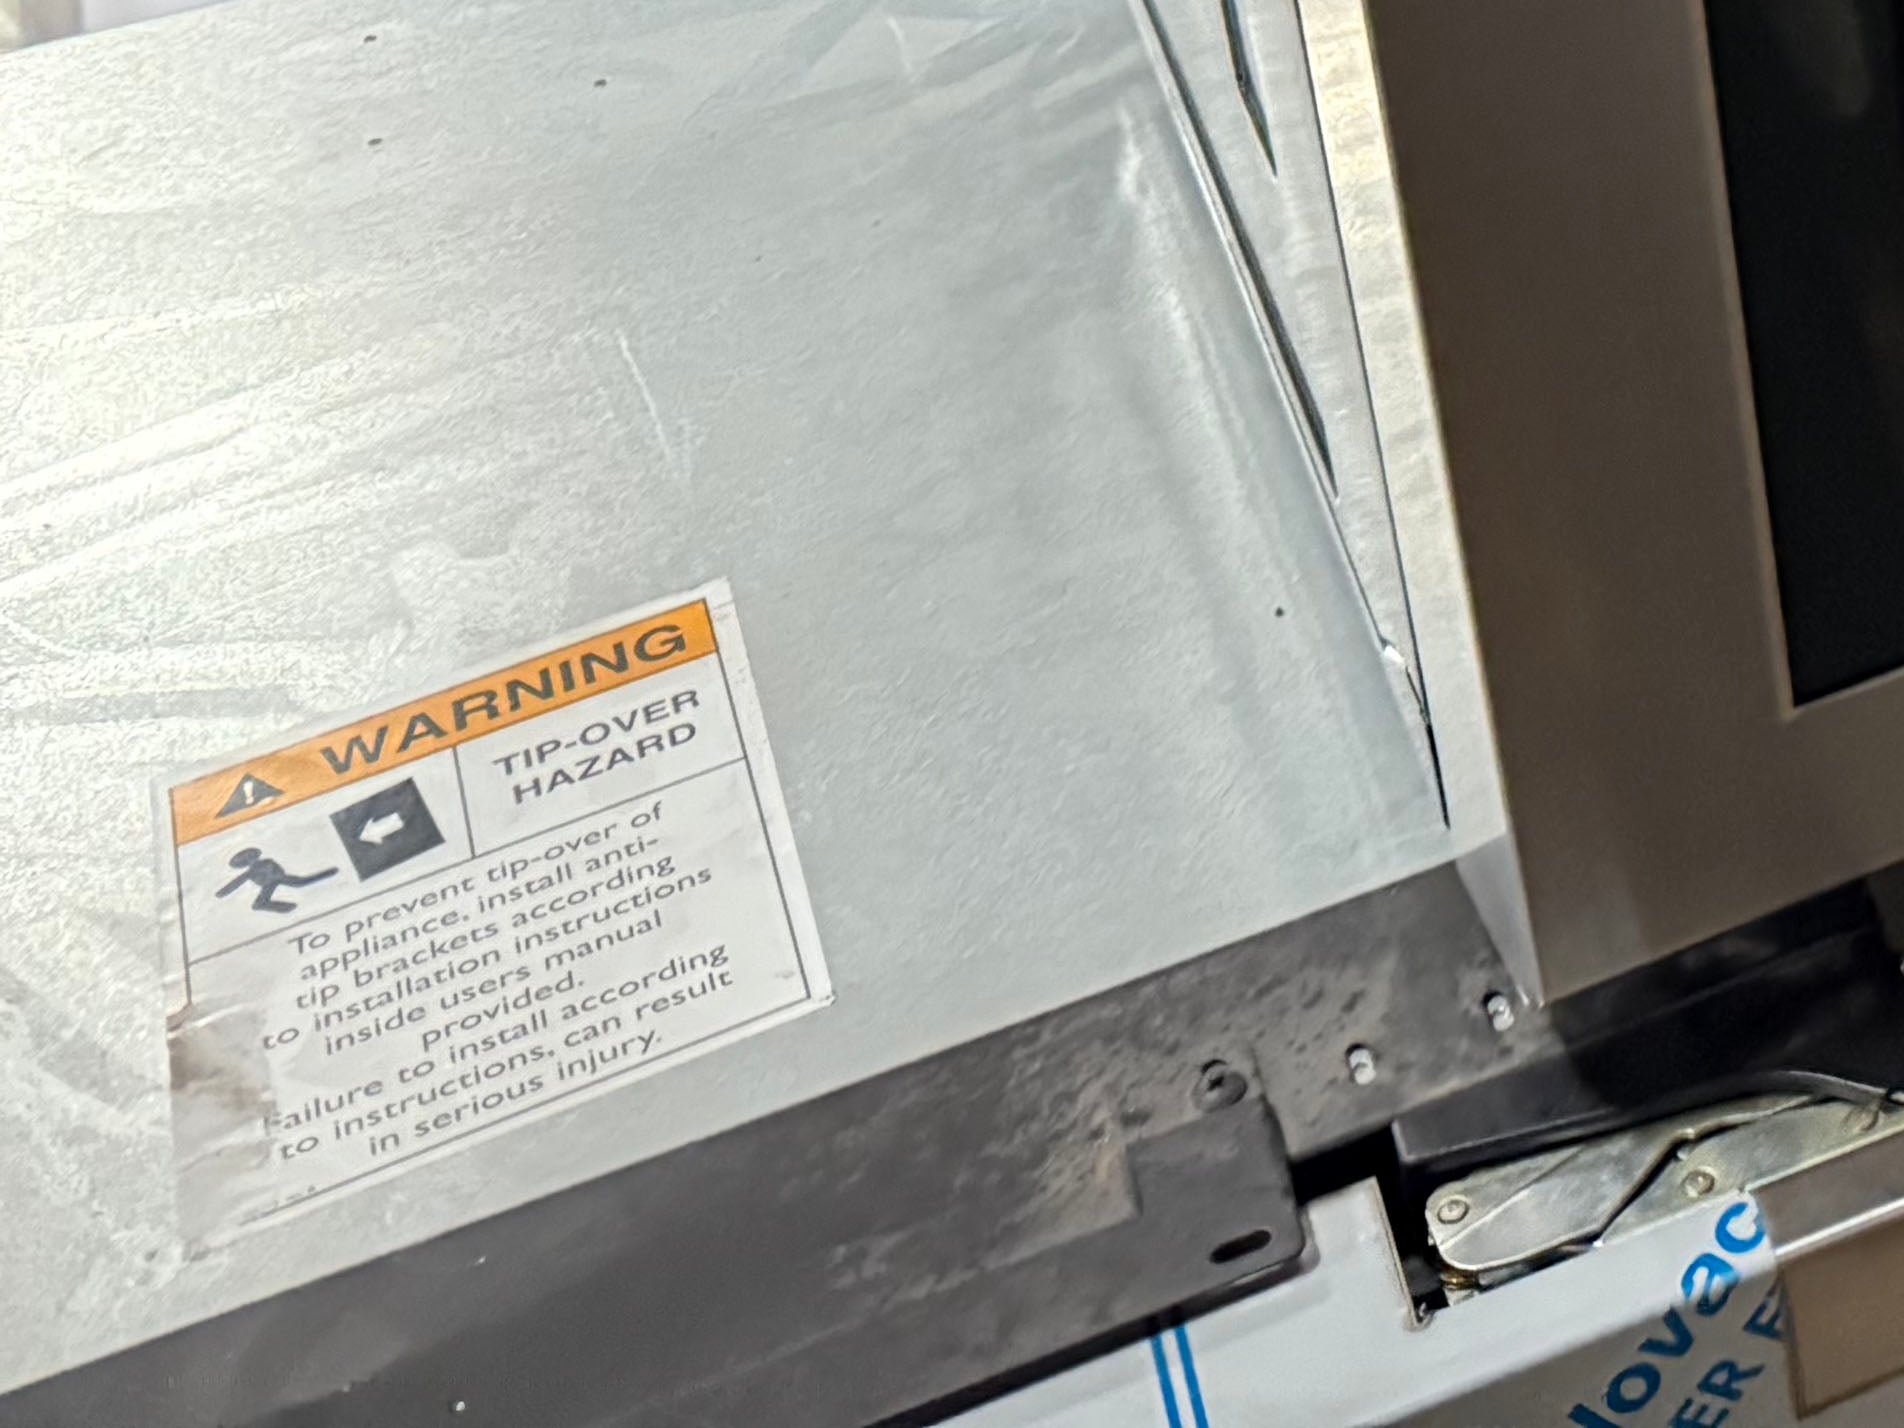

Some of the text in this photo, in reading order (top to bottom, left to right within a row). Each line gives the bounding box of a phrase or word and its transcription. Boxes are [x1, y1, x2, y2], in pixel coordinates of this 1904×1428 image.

[319, 624, 687, 775] WARNING
[493, 690, 700, 776] TIP-OVER
[512, 722, 697, 805] HAZARD
[288, 800, 663, 955] To prevent tip-over of
[296, 855, 677, 1010] tip brackets according
[478, 861, 573, 914] install
[585, 836, 660, 874] anti-
[262, 867, 713, 1051] to installation instructions
[325, 908, 663, 1057] inside users manual
[397, 1060, 436, 1085] to
[448, 1009, 548, 1065] install
[561, 944, 730, 1022] according
[421, 970, 585, 1053] provided.
[279, 1135, 320, 1161] to
[563, 1014, 622, 1048] can
[634, 971, 734, 1022] result
[368, 1029, 663, 1157] in serious injury.
